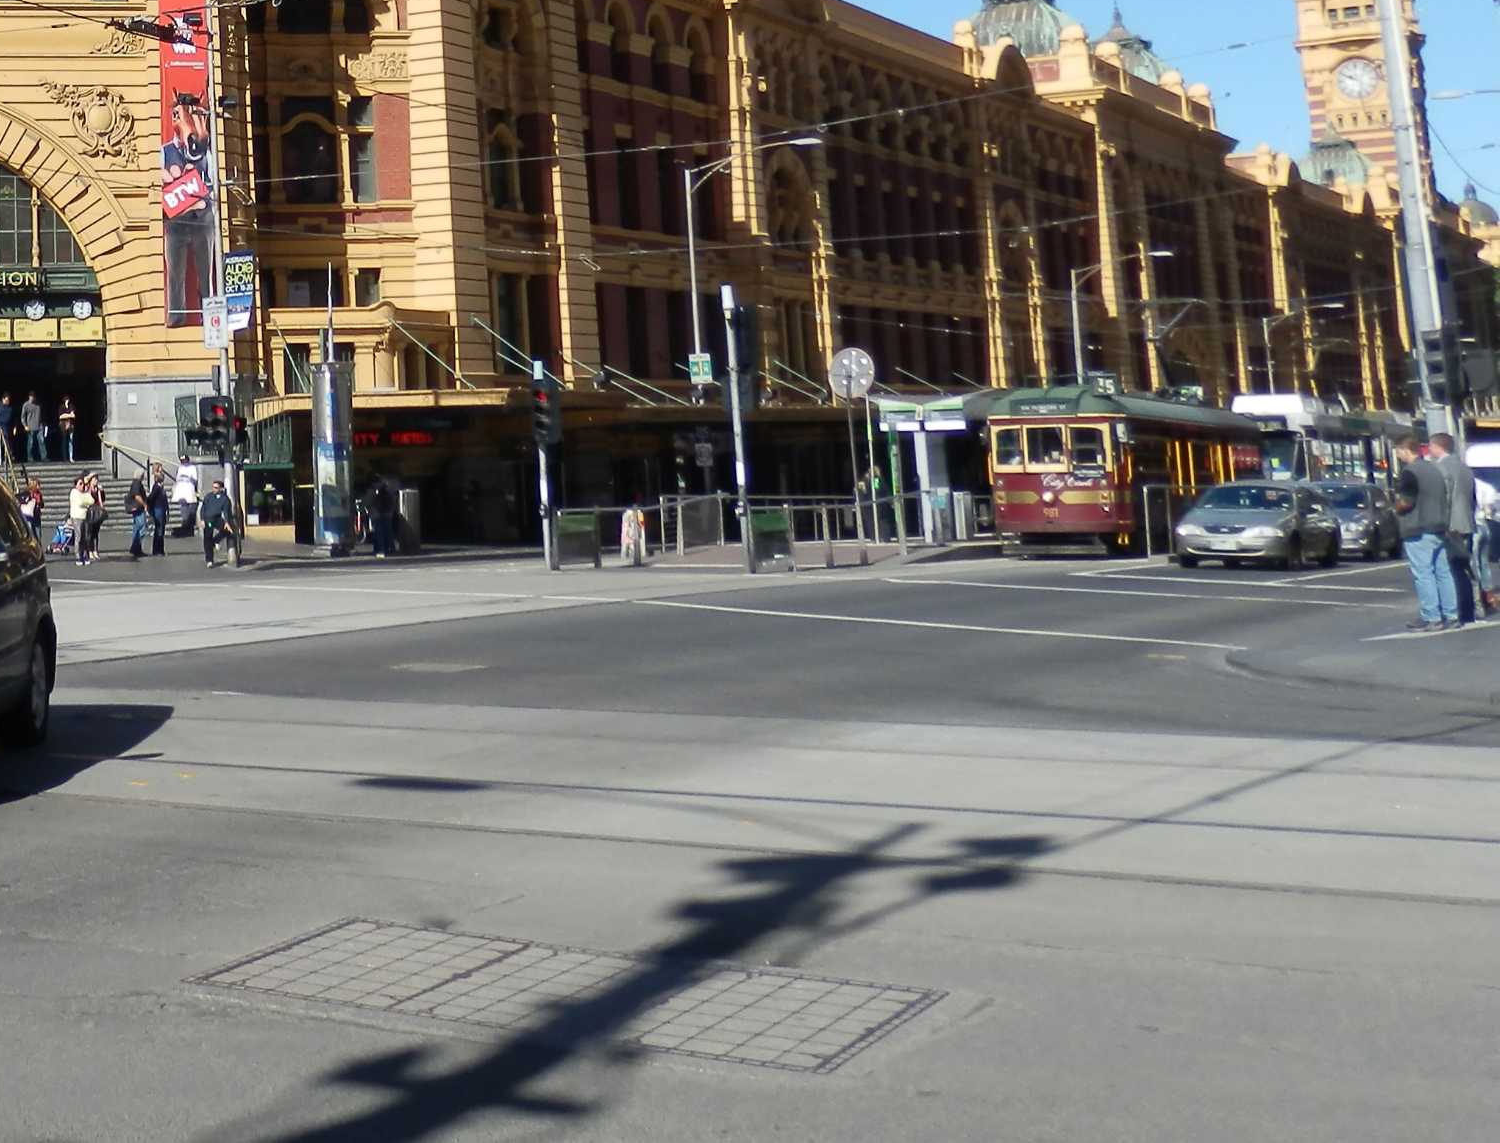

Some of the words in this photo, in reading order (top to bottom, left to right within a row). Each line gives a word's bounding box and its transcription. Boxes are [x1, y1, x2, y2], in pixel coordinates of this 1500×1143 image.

[164, 177, 200, 208] BTW
[225, 262, 254, 276] AUDIO
[225, 272, 254, 286] SHOW
[225, 285, 239, 293] OCT
